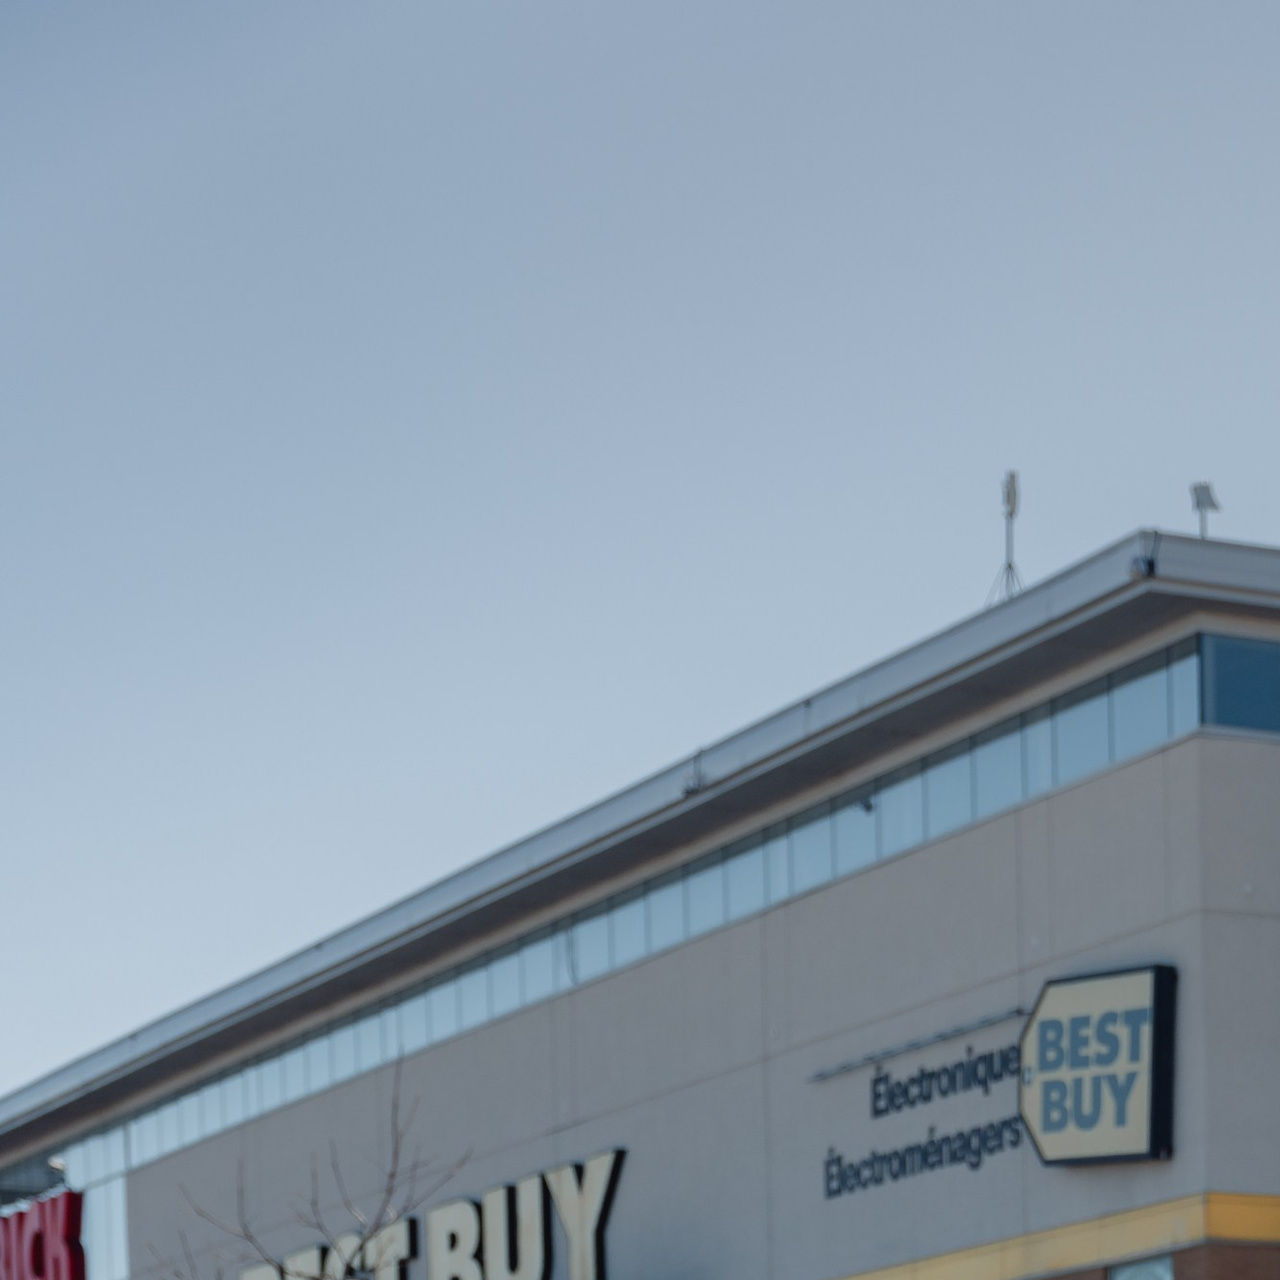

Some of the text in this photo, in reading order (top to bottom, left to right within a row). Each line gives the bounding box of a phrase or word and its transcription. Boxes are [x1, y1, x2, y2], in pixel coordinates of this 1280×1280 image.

[1037, 1008, 1151, 1072] BEST
[869, 1044, 1021, 1120] Électronique
[1041, 1072, 1138, 1133] BUY
[823, 1115, 1023, 1200] Électroménagers
